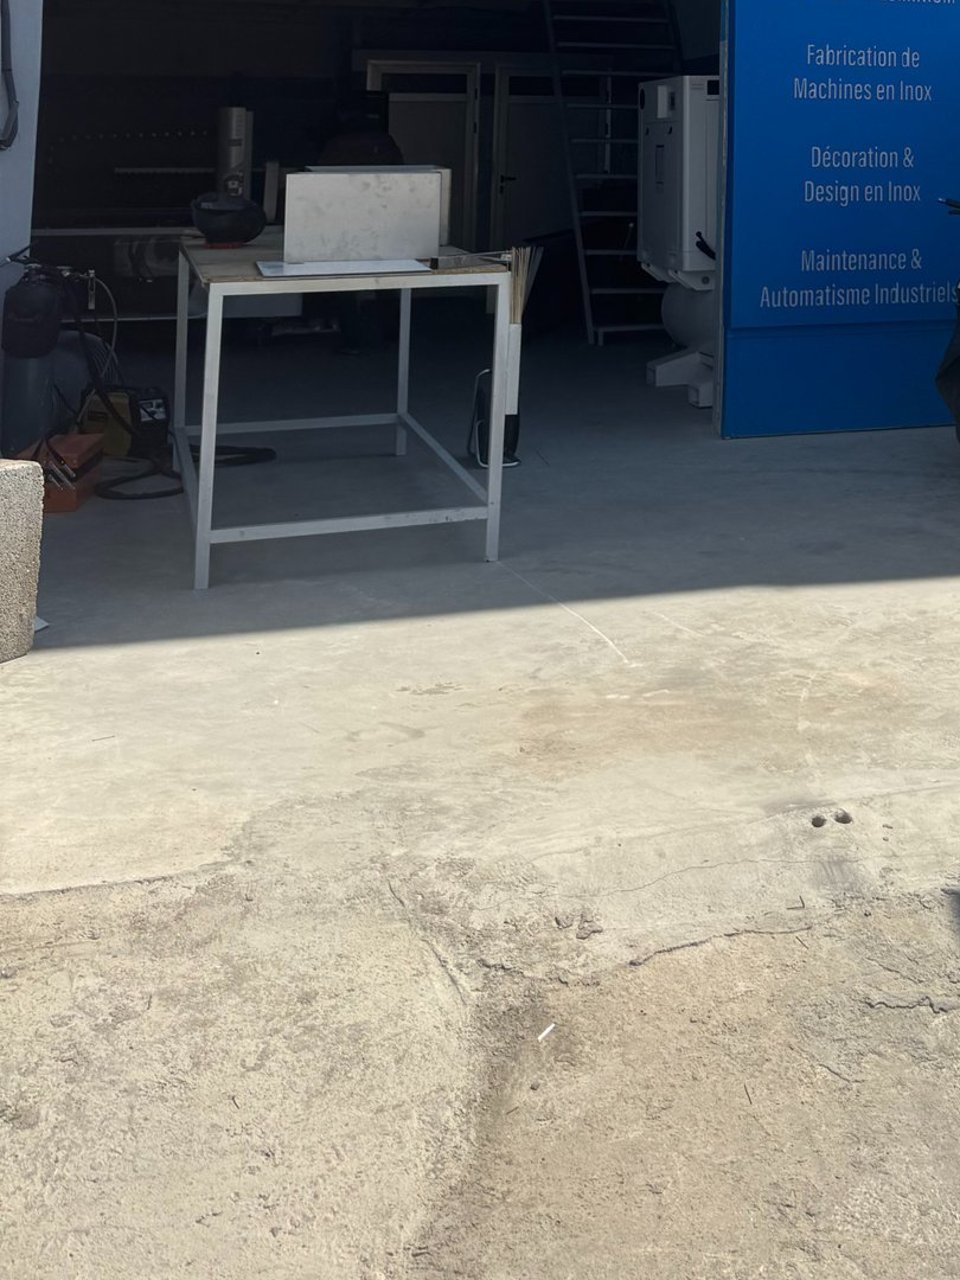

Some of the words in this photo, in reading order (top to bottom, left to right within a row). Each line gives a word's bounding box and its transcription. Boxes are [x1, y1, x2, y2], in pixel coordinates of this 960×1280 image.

[806, 43, 897, 68] Fabrication
[901, 47, 920, 68] de
[793, 77, 872, 101] Machines
[876, 84, 895, 101] en
[900, 80, 933, 102] Inox
[811, 145, 898, 168] Décoration
[903, 147, 915, 168] &
[804, 180, 860, 207] Design
[864, 185, 884, 202] en
[888, 181, 921, 202] Inox
[801, 249, 907, 272] Maintenance
[911, 248, 923, 270] &
[760, 283, 871, 308] Automatisme
